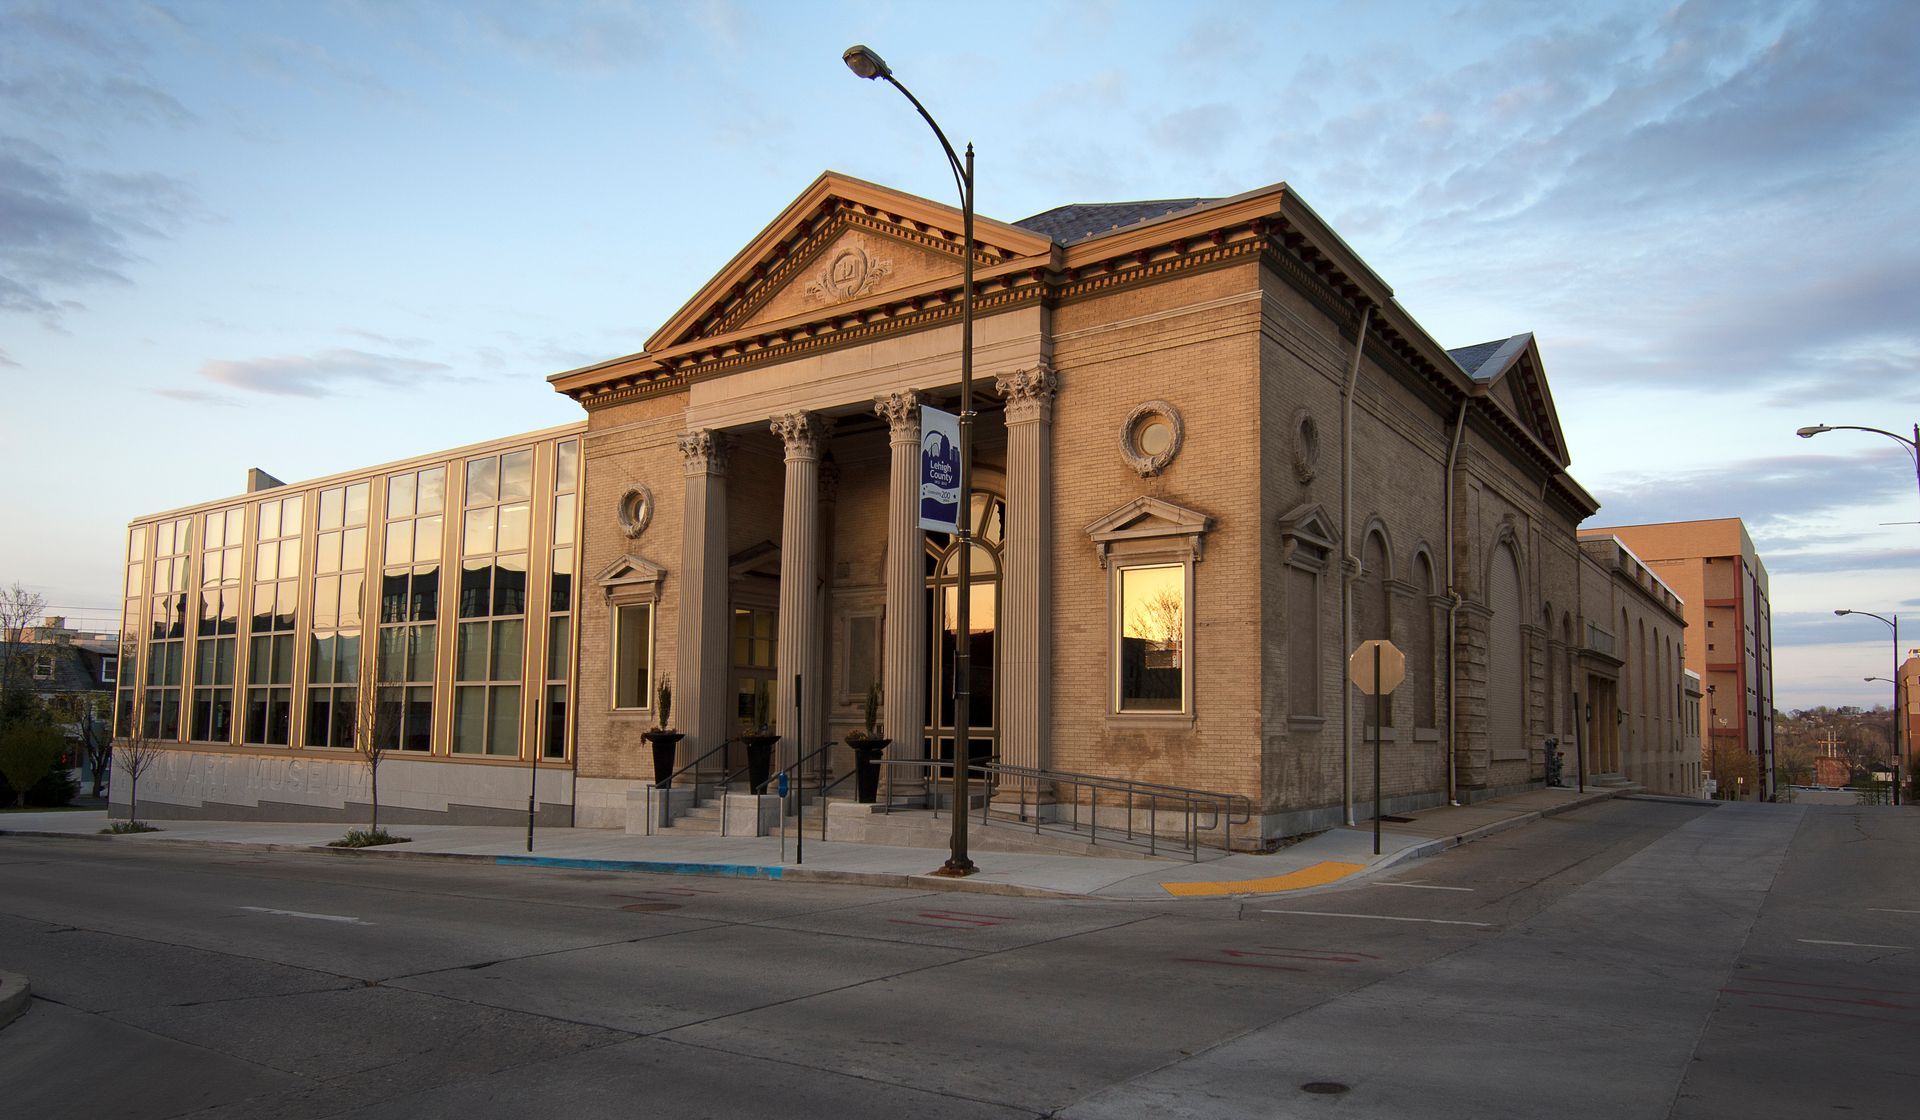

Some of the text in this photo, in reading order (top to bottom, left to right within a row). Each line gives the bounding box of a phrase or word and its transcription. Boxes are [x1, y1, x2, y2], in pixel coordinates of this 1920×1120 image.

[930, 460, 952, 473] Lehigh
[930, 469, 953, 484] County
[185, 753, 232, 786] ART
[246, 755, 372, 799] MUSEUM
